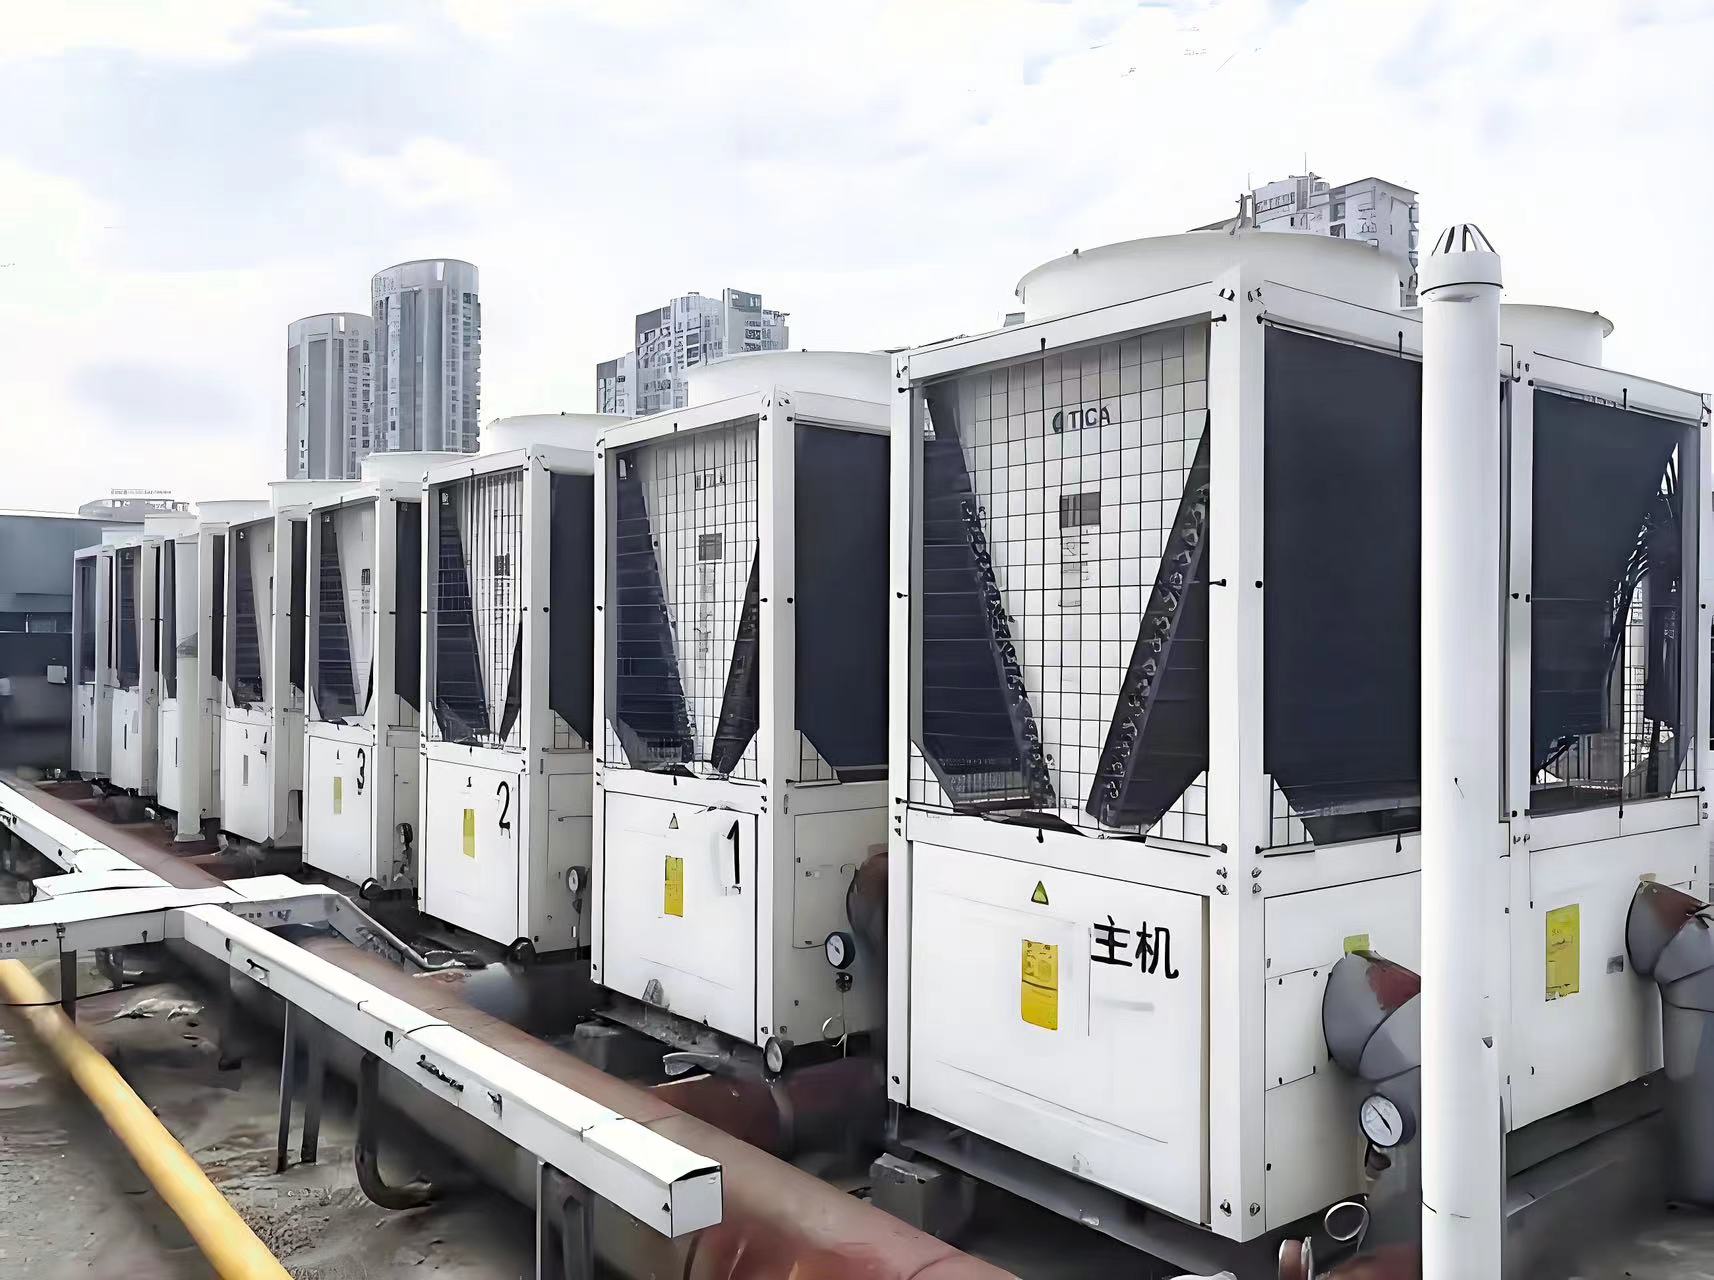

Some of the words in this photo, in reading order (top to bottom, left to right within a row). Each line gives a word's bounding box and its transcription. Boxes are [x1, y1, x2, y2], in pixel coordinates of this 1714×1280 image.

[356, 747, 366, 795] 3
[496, 780, 511, 832] 2
[726, 819, 742, 887] 1
[1090, 914, 1179, 979] 主机
